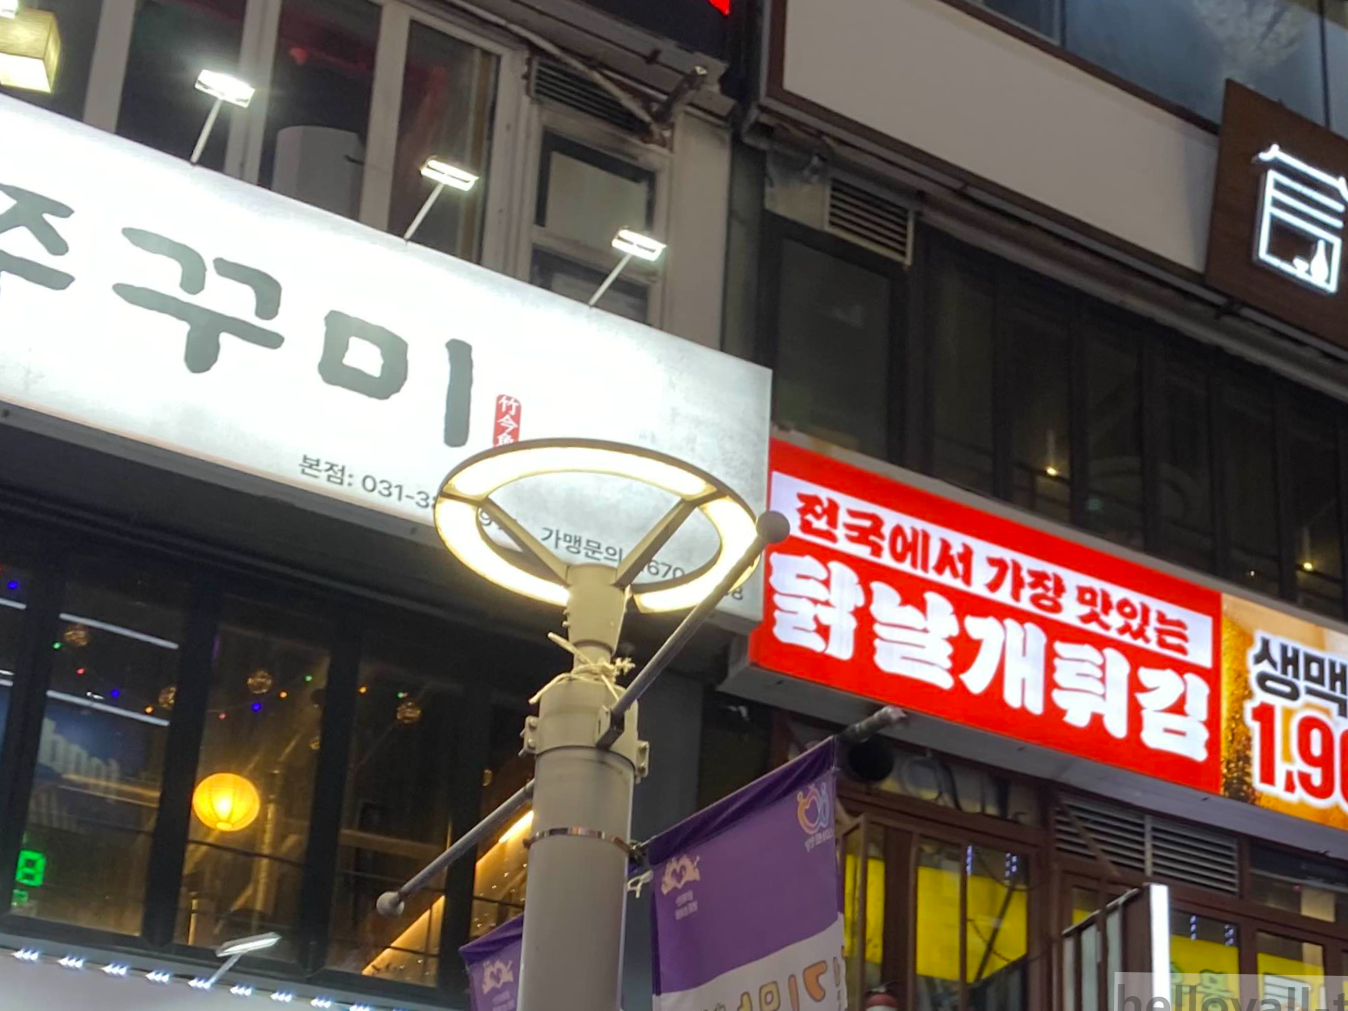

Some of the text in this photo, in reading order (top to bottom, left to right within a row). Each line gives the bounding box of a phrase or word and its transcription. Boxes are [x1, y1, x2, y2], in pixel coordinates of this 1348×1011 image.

[541, 526, 624, 563] 가맹문의
[796, 492, 974, 587] 전국에서
[986, 557, 1064, 613] 가장
[1075, 587, 1189, 657] 맛있는
[769, 551, 1211, 763] 닭날개튀김
